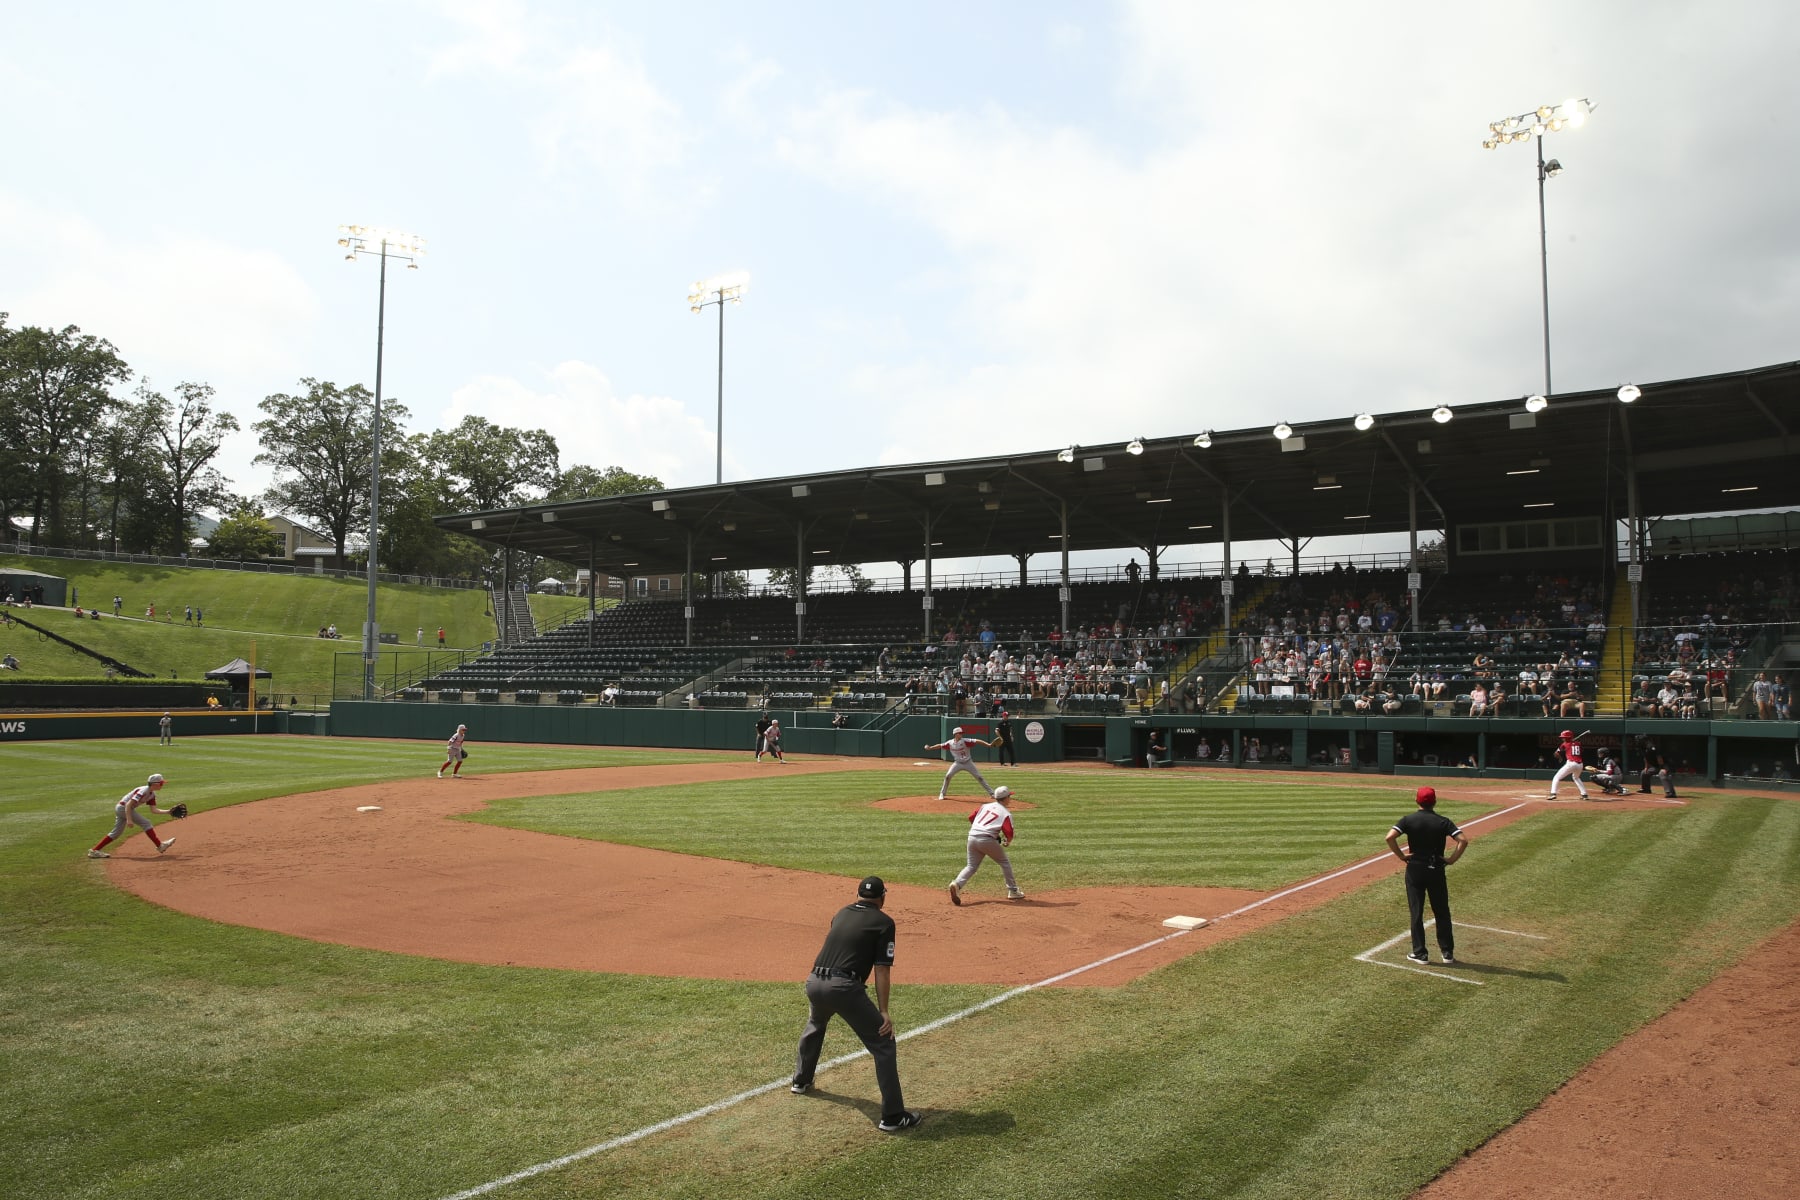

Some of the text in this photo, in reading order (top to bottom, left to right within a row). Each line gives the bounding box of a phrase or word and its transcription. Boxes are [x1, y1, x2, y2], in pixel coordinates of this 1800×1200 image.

[0, 721, 26, 733] WS
[1571, 745, 1581, 756] 18
[977, 810, 999, 826] 17
